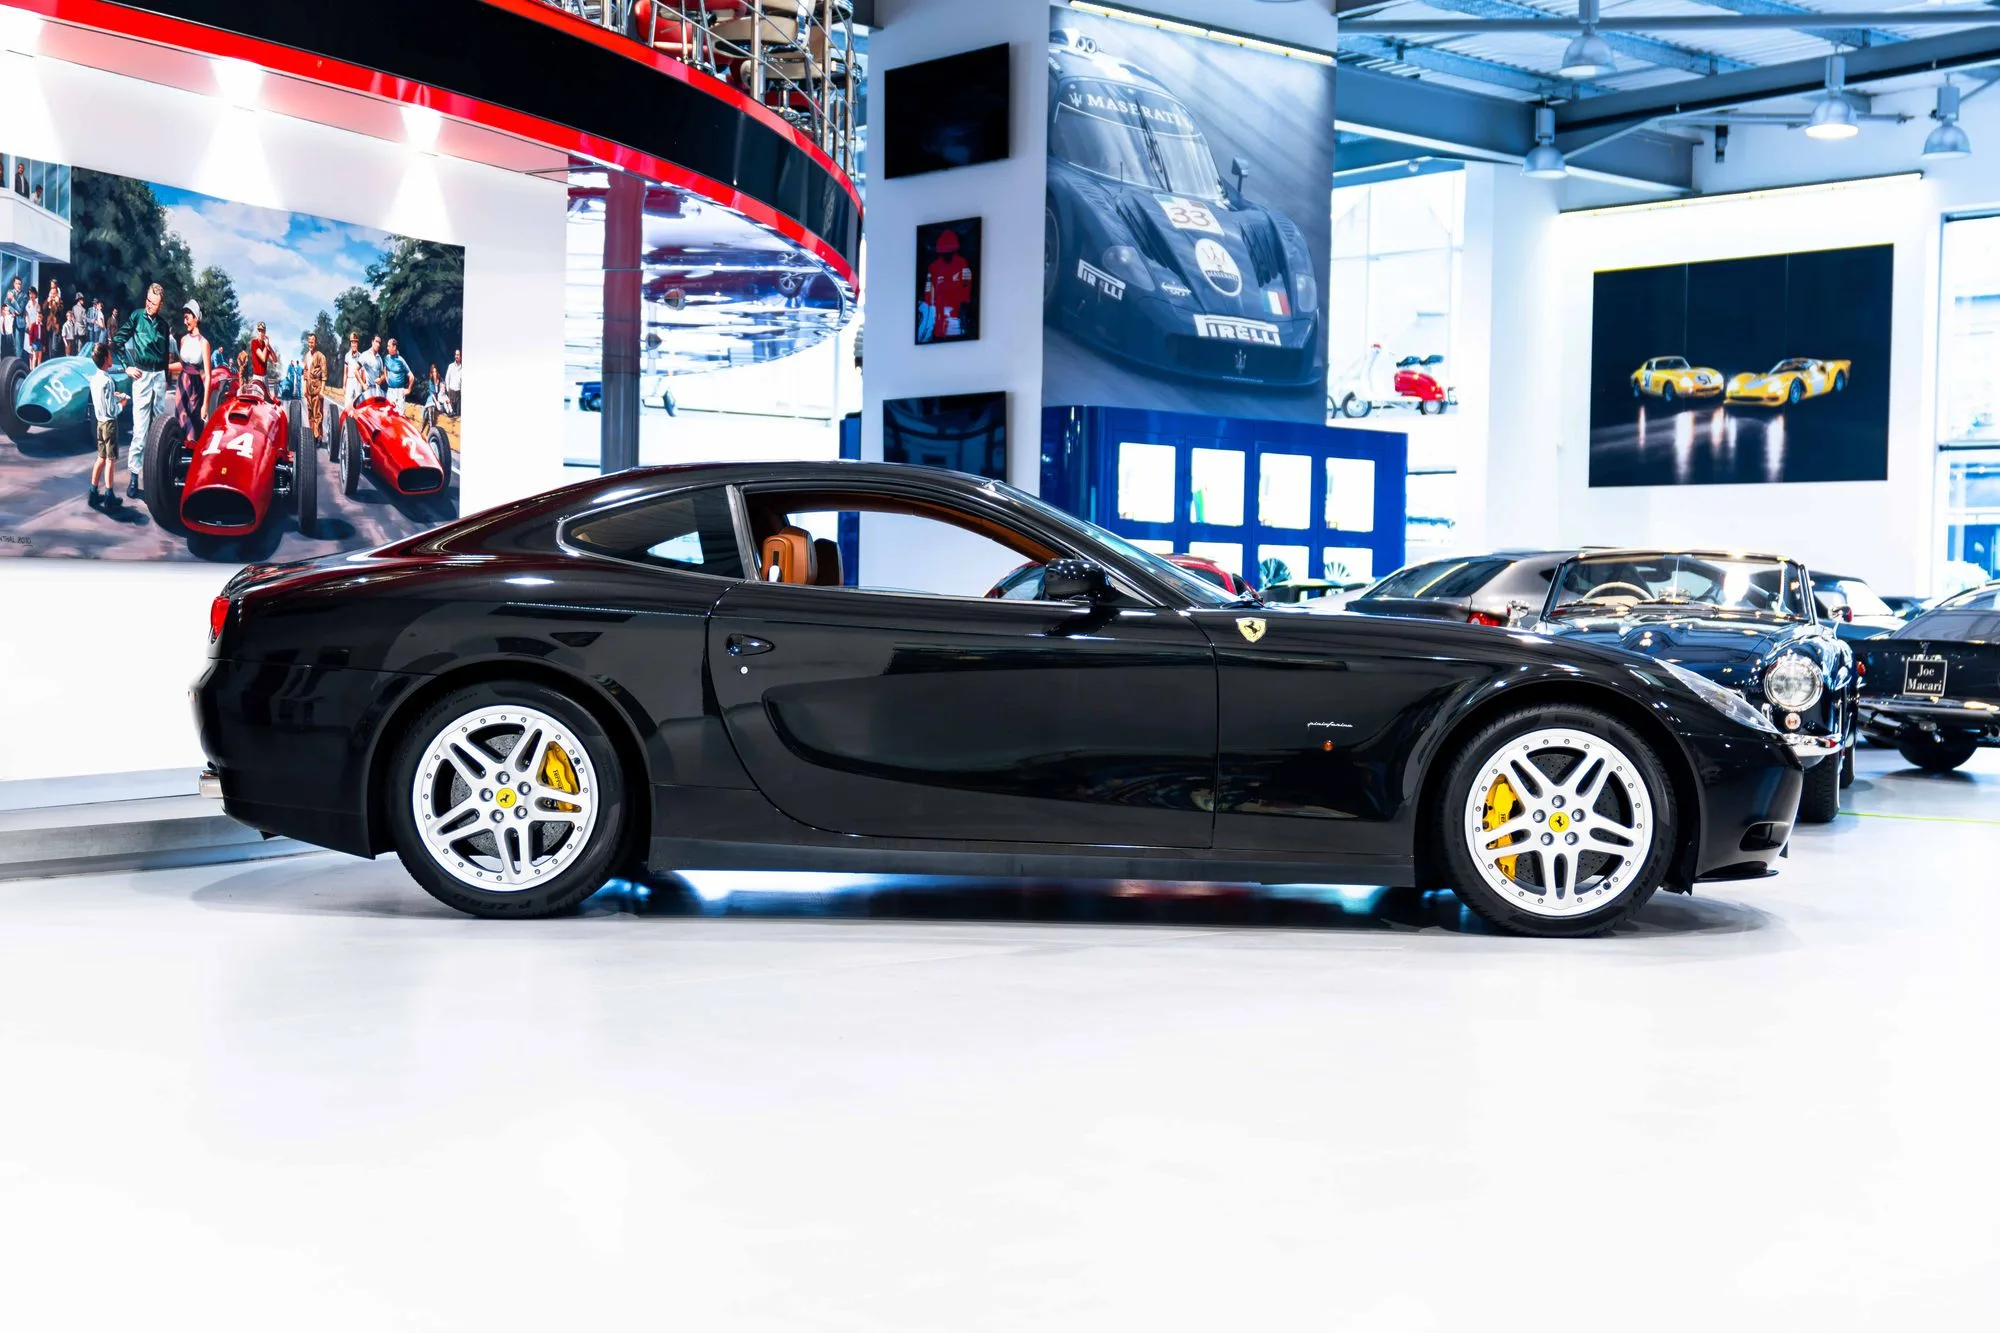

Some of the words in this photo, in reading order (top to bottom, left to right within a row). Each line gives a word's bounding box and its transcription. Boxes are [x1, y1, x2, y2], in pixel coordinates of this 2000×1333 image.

[1170, 207, 1211, 227] 33
[1193, 313, 1282, 347] PIRELLI
[43, 375, 73, 405] 18
[201, 430, 254, 460] 14
[402, 438, 425, 460] 2
[1917, 664, 1935, 677] Joe
[1907, 678, 1943, 691] Macari
